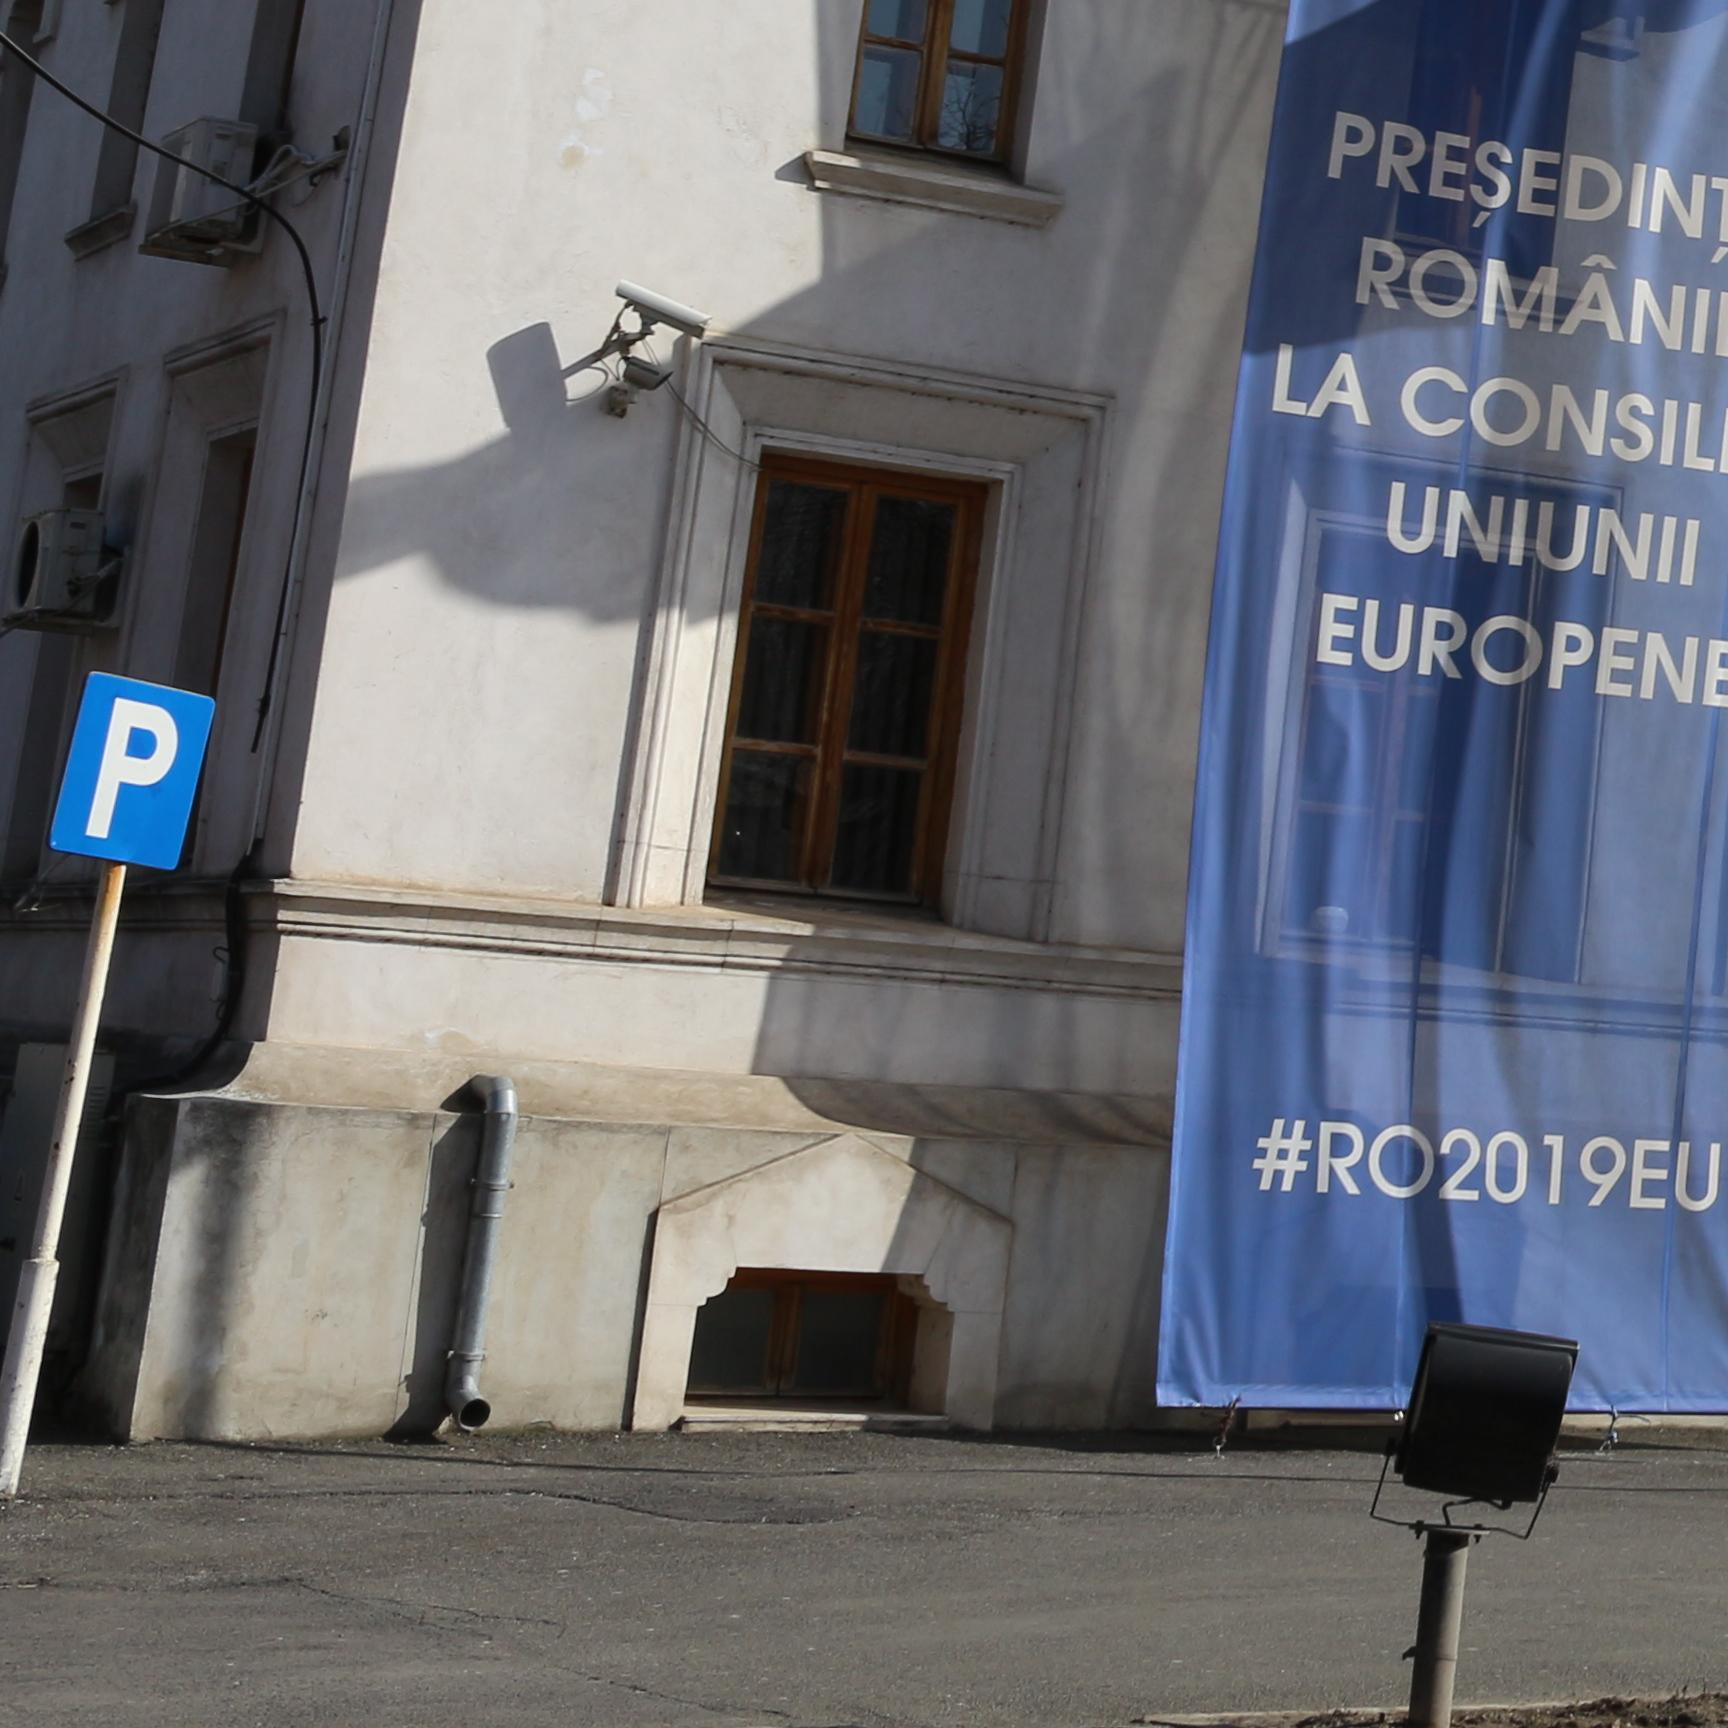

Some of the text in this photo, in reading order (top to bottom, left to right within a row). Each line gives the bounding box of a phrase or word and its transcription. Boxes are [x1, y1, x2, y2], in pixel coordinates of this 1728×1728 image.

[1271, 342, 1372, 426] LA
[1386, 480, 1701, 587] UNIUNII
[84, 696, 179, 840] P
[1252, 1117, 1722, 1213] #RO2019EU
